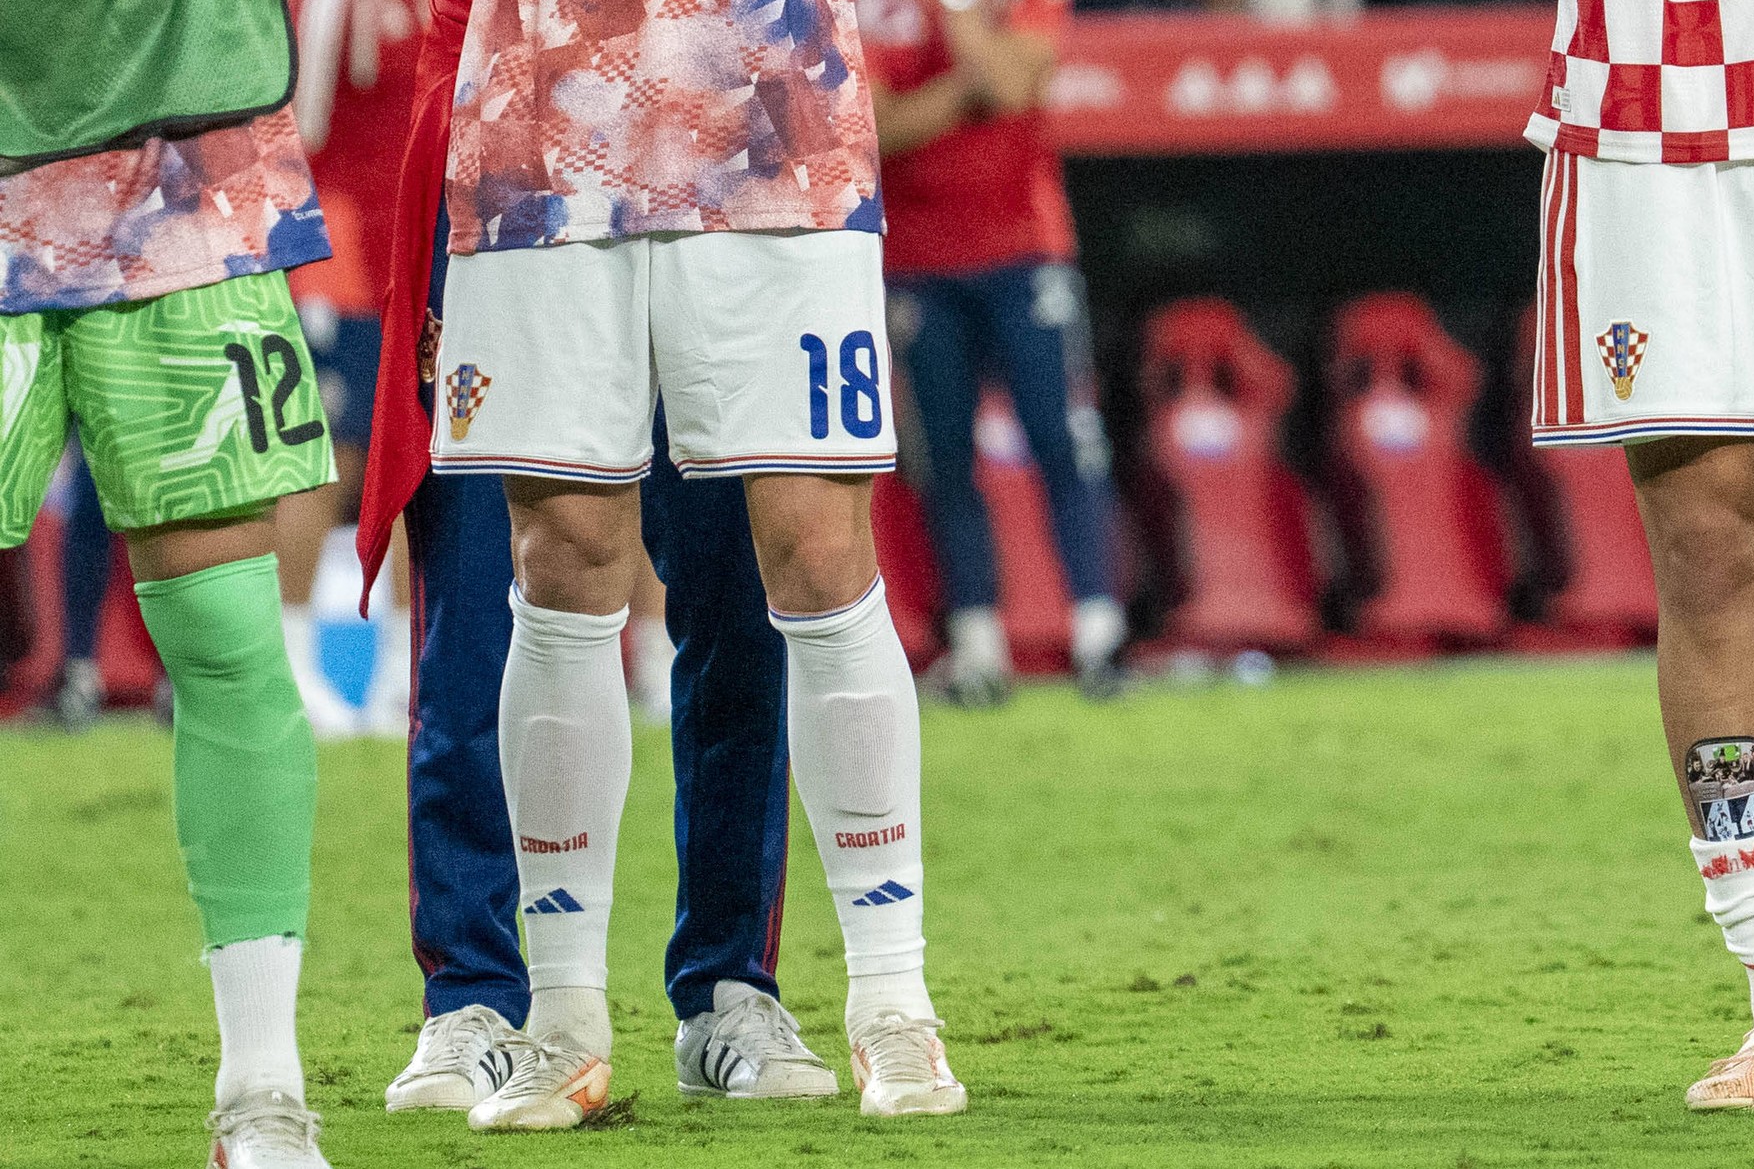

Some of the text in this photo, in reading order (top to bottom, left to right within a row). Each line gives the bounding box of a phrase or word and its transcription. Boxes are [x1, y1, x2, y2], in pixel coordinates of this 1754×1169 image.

[223, 333, 325, 453] 12
[799, 329, 883, 440] 18
[520, 831, 588, 854] CROATIA
[834, 822, 906, 849] CROATIA
